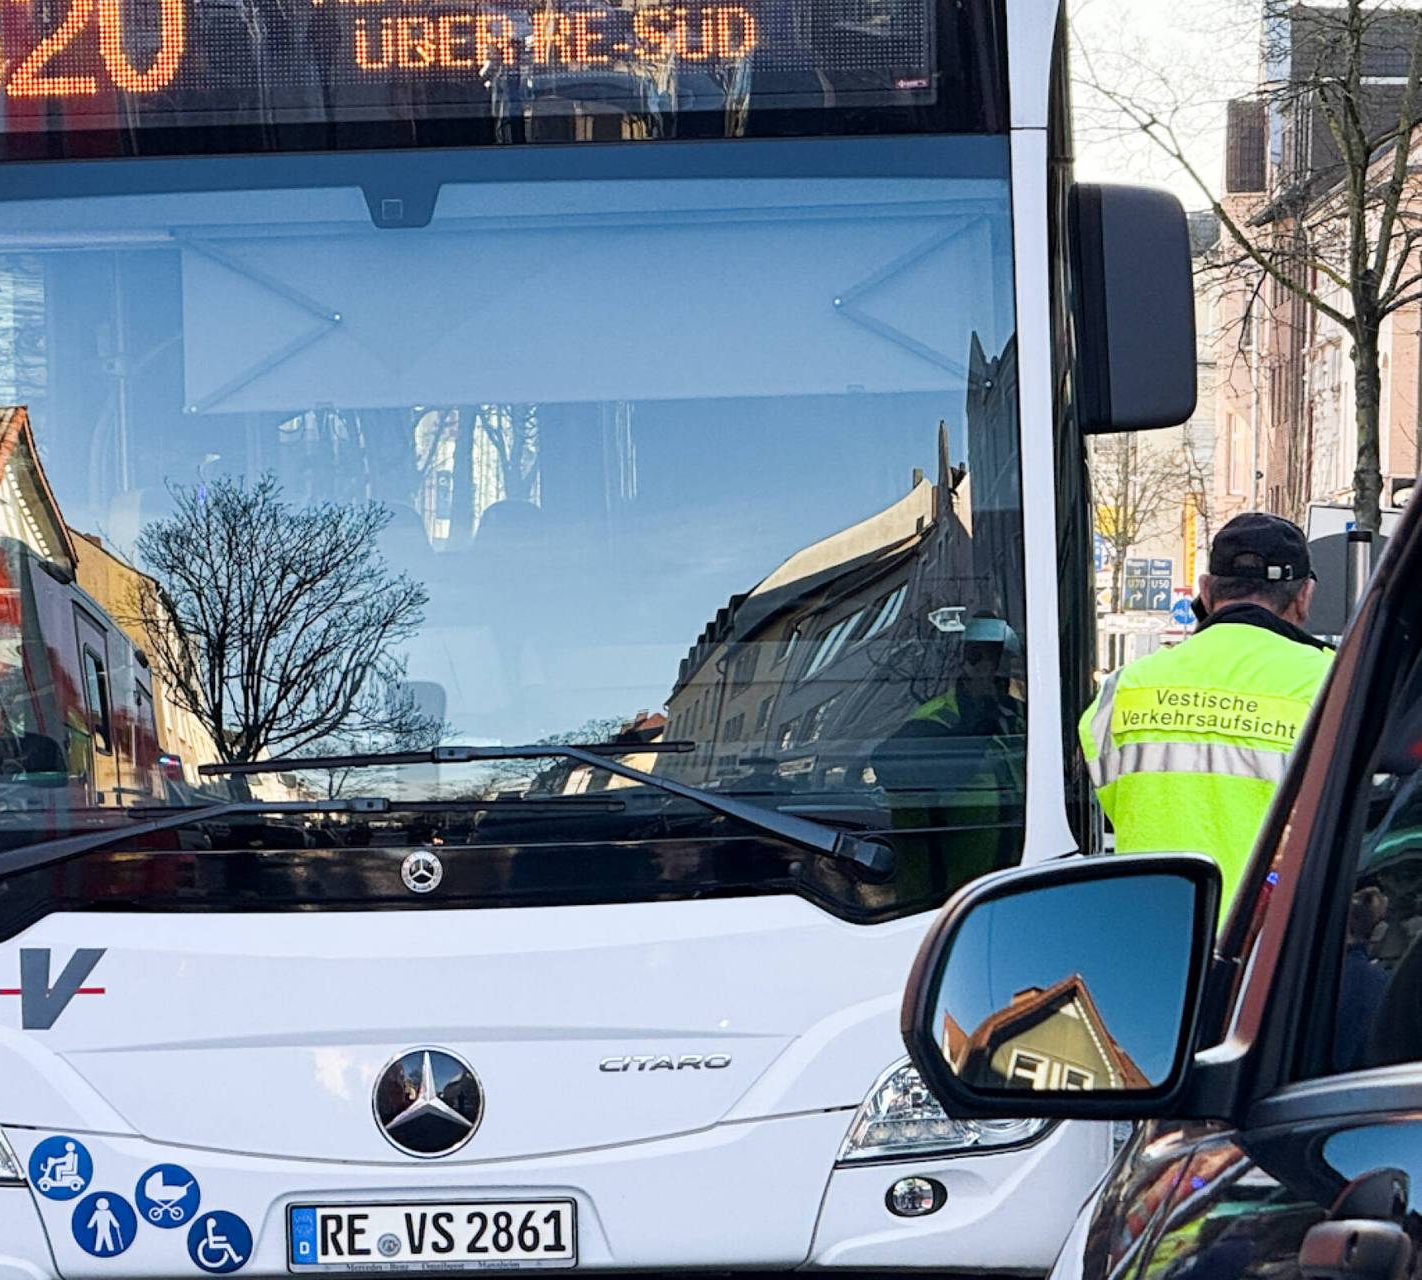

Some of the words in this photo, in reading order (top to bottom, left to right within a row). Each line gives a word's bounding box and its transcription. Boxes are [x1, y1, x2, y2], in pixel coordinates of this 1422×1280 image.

[355, 13, 515, 70] ÜBER
[532, 7, 756, 64] RE-SÜD
[1156, 689, 1259, 713] Vestische
[1122, 709, 1297, 739] Verkehrsaufsicht
[599, 1053, 733, 1073] CITARO
[321, 1213, 372, 1257] RE
[405, 1212, 456, 1255] VS
[467, 1209, 567, 1253] 2861
[299, 1241, 310, 1255] D
